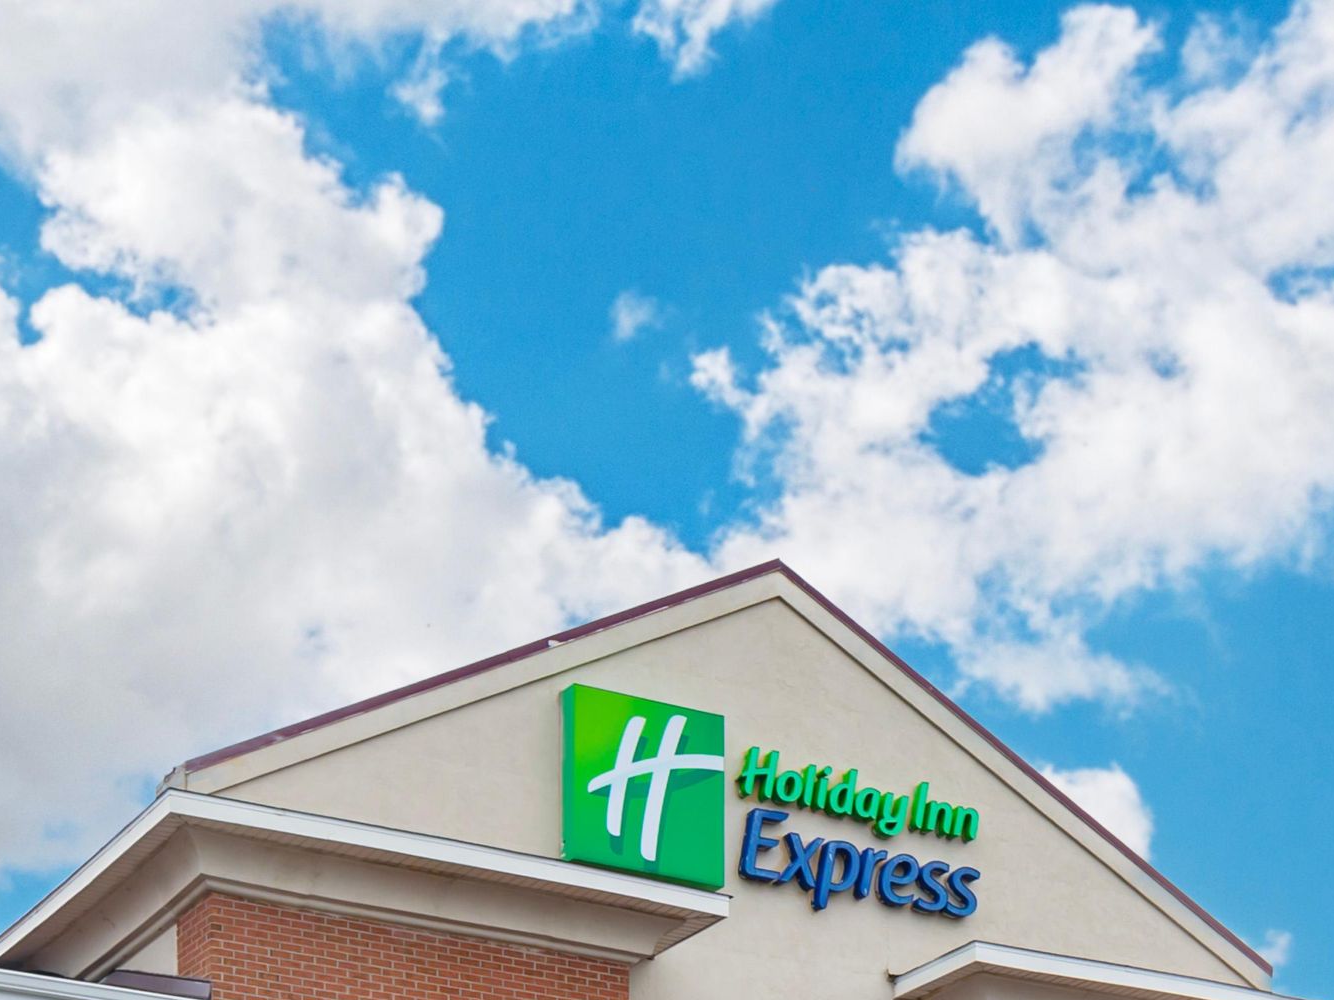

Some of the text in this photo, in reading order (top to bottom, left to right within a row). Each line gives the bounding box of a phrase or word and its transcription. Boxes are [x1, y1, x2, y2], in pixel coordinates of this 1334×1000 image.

[737, 746, 979, 842] Holiday Inn
[739, 808, 980, 917] Express
